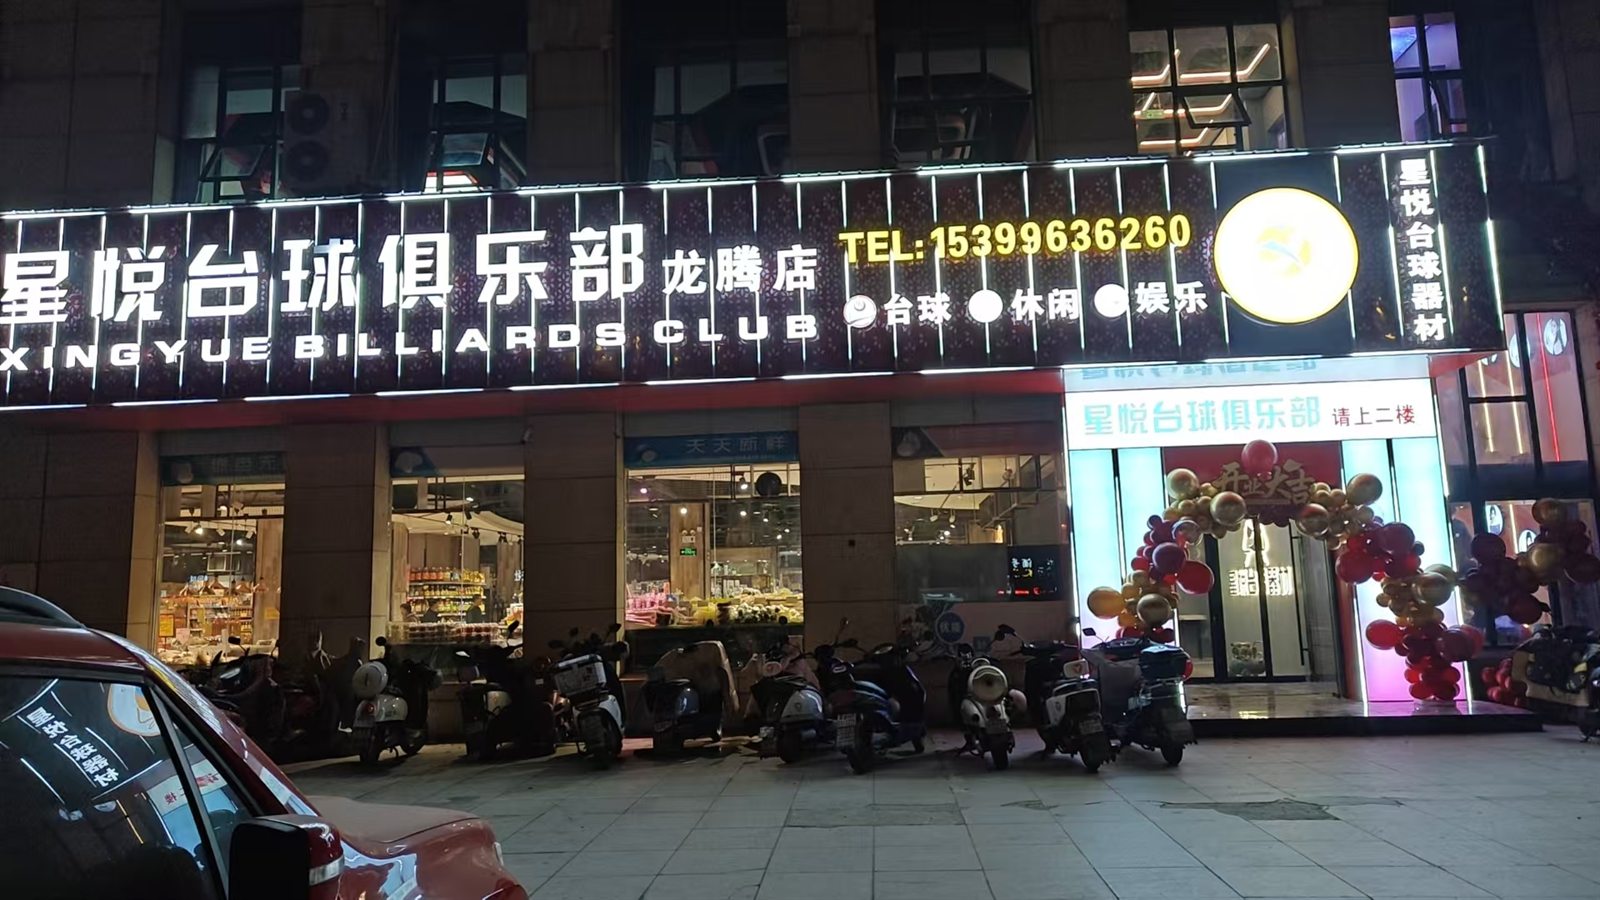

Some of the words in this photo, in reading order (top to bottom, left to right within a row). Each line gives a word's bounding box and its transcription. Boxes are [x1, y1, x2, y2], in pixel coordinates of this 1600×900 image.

[0, 223, 645, 325] 星悦台球俱乐部
[661, 243, 818, 295] 龙腾店
[1399, 158, 1447, 341] 星悦台球器材
[883, 291, 952, 327] 台球
[1010, 287, 1080, 321] 休闲
[1134, 280, 1209, 315] 娱乐
[0, 336, 271, 371] XINGYUE
[294, 322, 627, 360] BILLIARDS
[653, 314, 818, 344] CLUB
[1083, 396, 1321, 435] 星悦台球俱乐部
[1331, 403, 1416, 428] 请上二楼
[1211, 458, 1316, 505] 开业大吉
